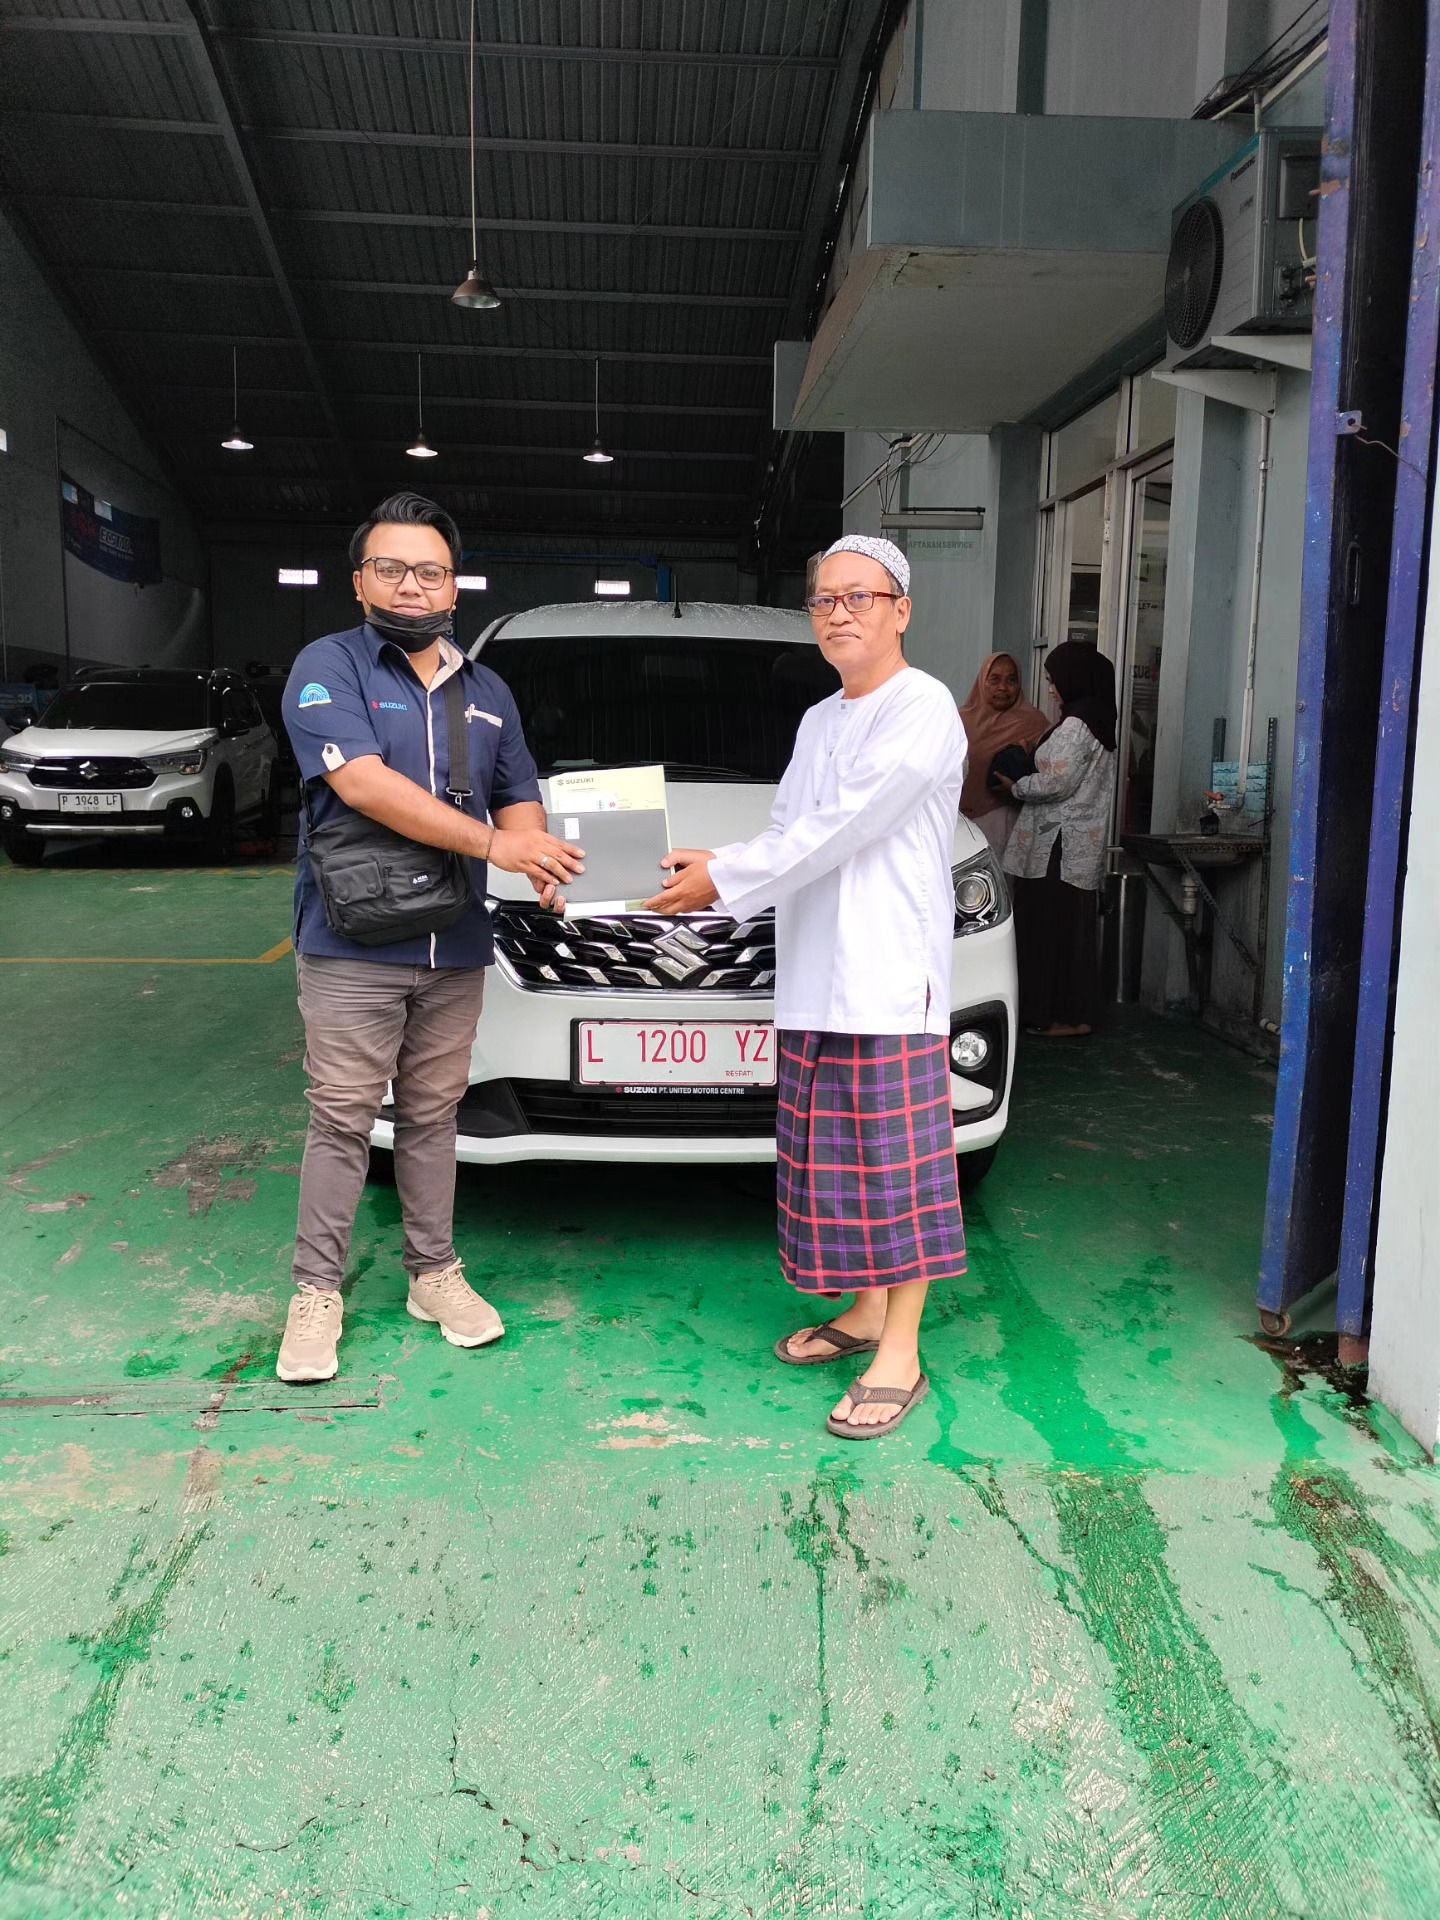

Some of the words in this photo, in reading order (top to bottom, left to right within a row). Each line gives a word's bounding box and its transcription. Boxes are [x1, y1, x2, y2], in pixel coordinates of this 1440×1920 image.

[907, 541, 942, 549] AFTARAN
[943, 541, 974, 549] SERVICE
[379, 701, 408, 711] SUZUKI
[565, 777, 594, 785] SUZUKI
[62, 795, 68, 806] P
[75, 795, 100, 806] 1948
[106, 795, 118, 806] LF
[587, 1029, 604, 1063] L
[637, 1029, 707, 1063] 1200
[735, 1029, 769, 1062] YZ
[623, 1086, 657, 1094] SUZUKI
[719, 1087, 745, 1095] CENTRE
